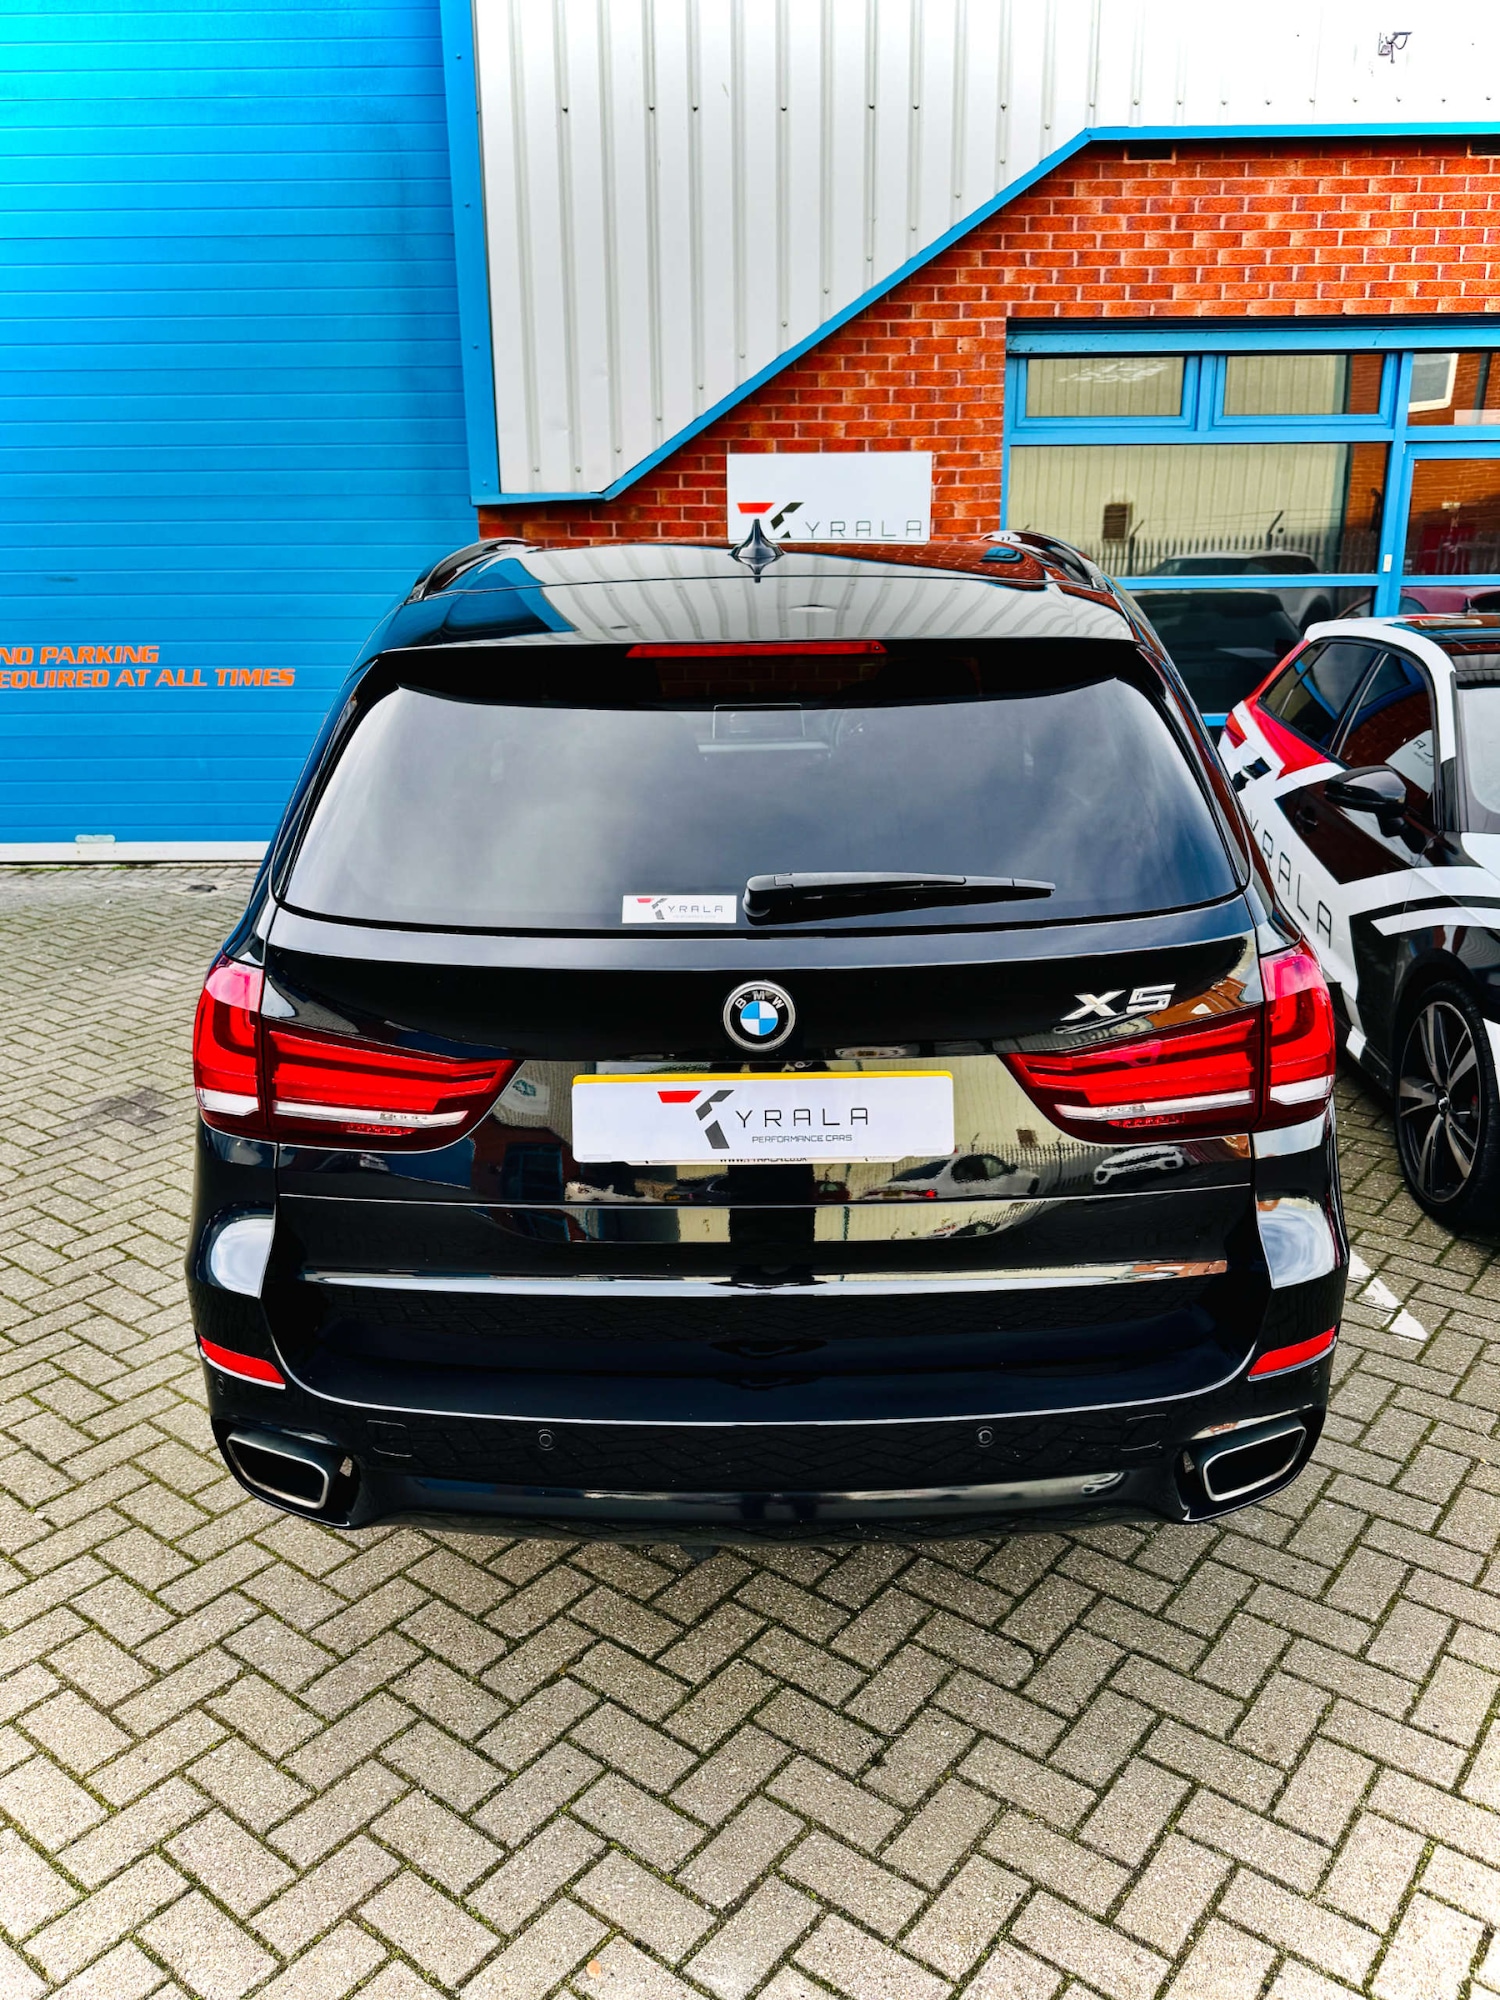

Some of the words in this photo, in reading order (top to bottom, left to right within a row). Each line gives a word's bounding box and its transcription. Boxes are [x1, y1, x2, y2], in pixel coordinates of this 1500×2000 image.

[0, 647, 34, 664] NO
[40, 645, 160, 664] PARKING
[115, 668, 151, 687] AT
[155, 669, 208, 687] ALL
[215, 668, 296, 687] TIMES
[735, 990, 785, 1010] BMW
[1060, 983, 1177, 1021] X5
[751, 1134, 824, 1144] PERFORMANCE
[825, 1133, 853, 1143] CARS
